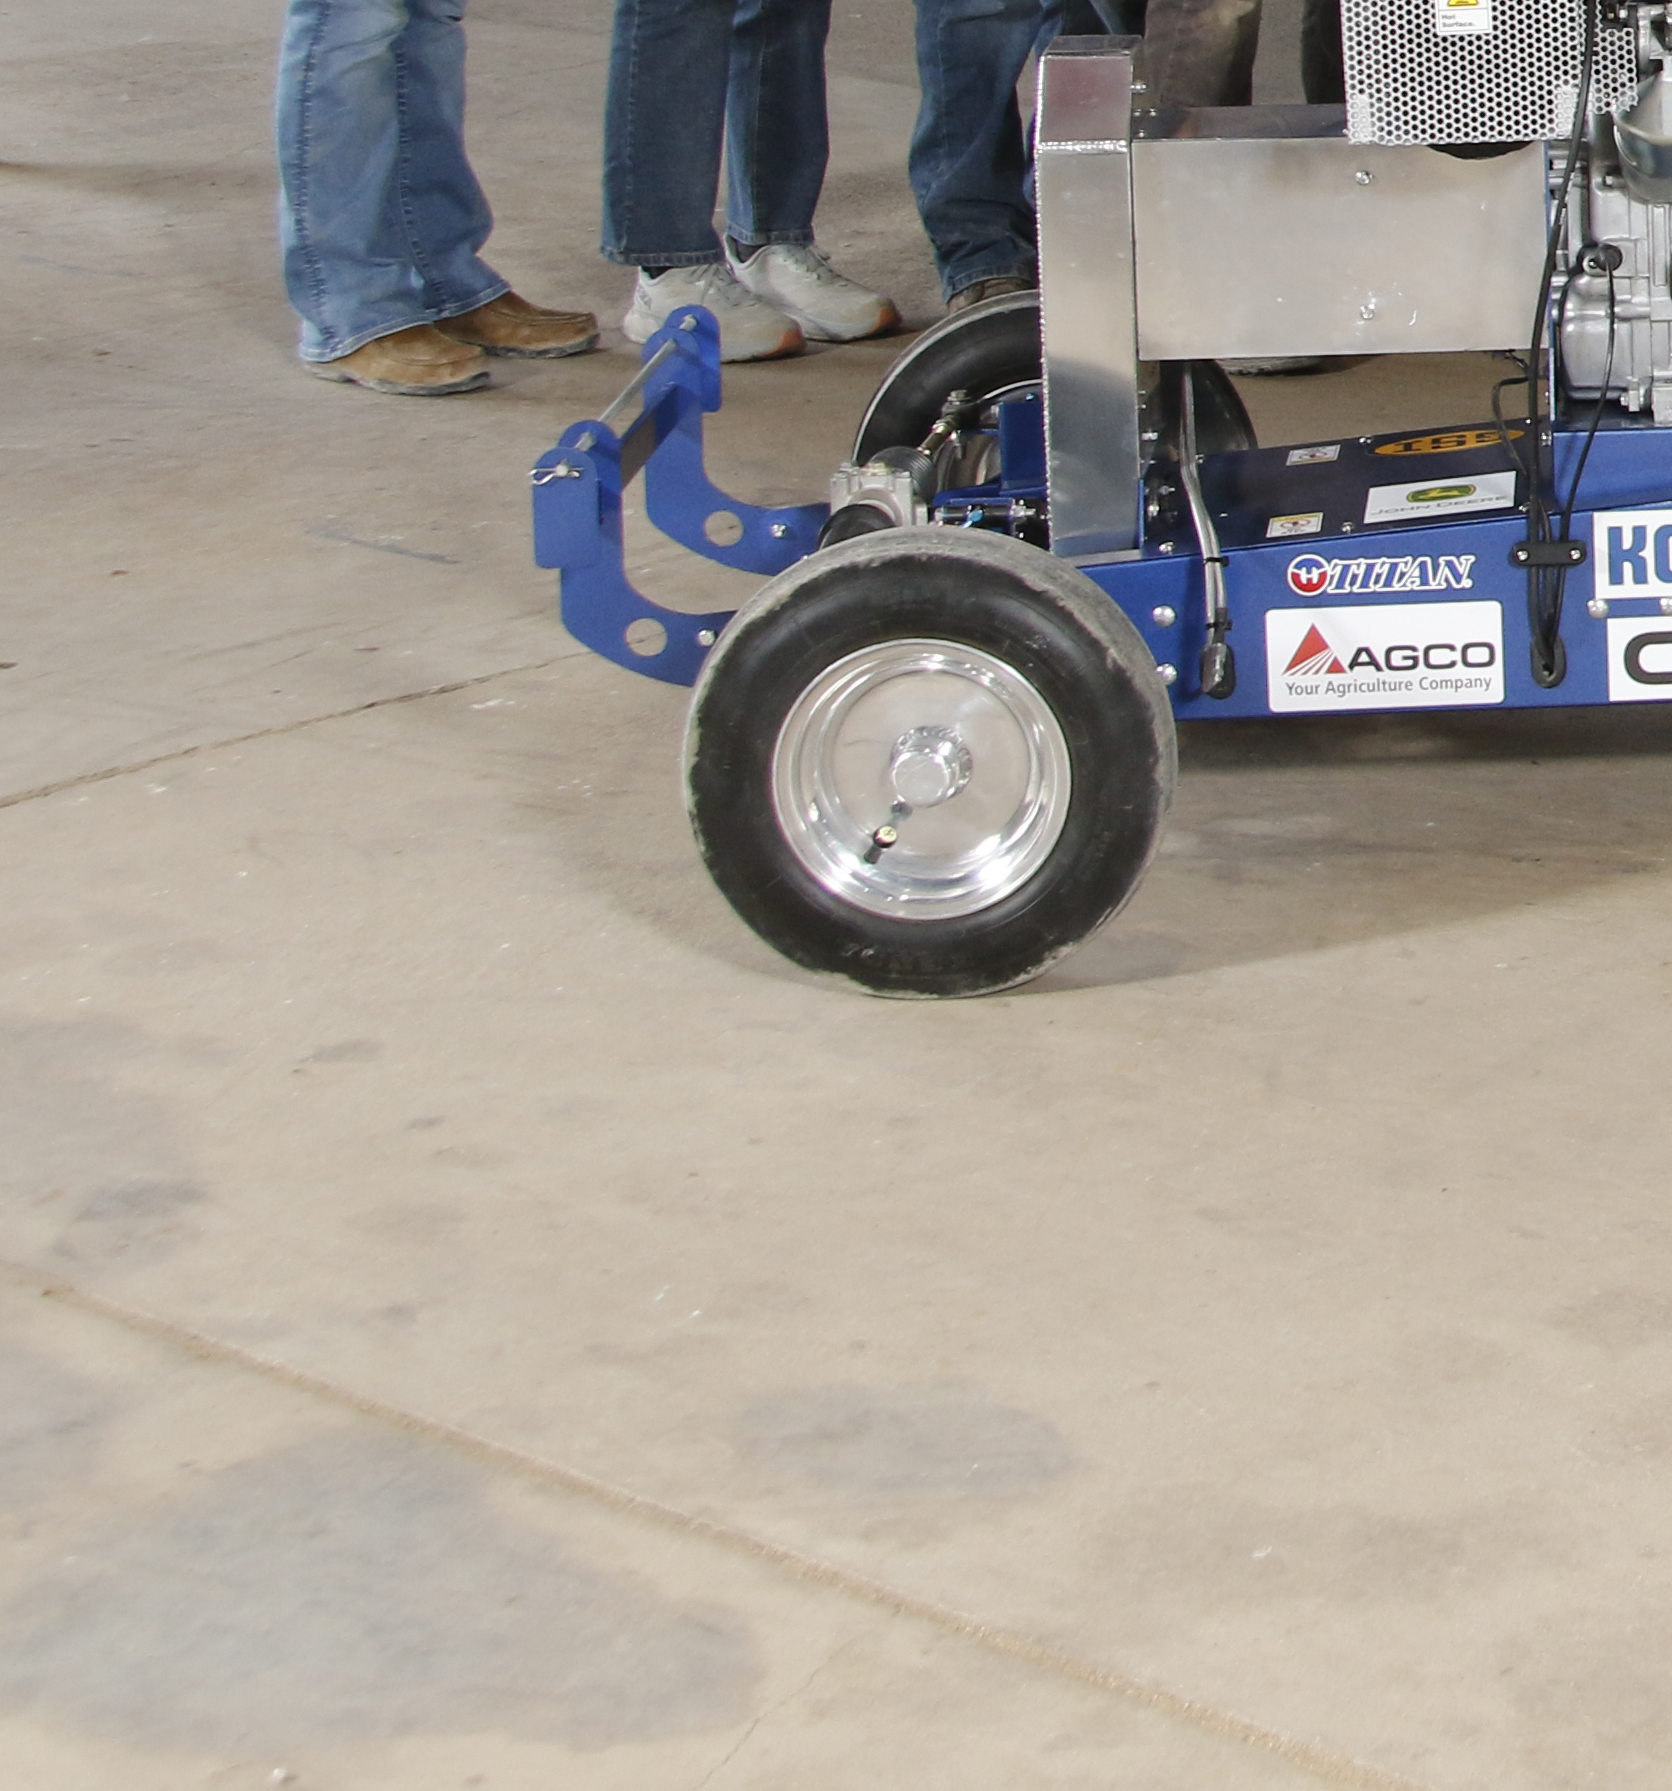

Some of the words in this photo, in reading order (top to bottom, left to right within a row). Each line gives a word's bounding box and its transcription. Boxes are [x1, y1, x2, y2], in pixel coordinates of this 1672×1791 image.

[1327, 555, 1477, 593] TITAN
[1348, 642, 1495, 672] AGCO
[1286, 682, 1320, 696] Your
[1324, 678, 1413, 697] Agriculture
[1418, 676, 1492, 692] Company
